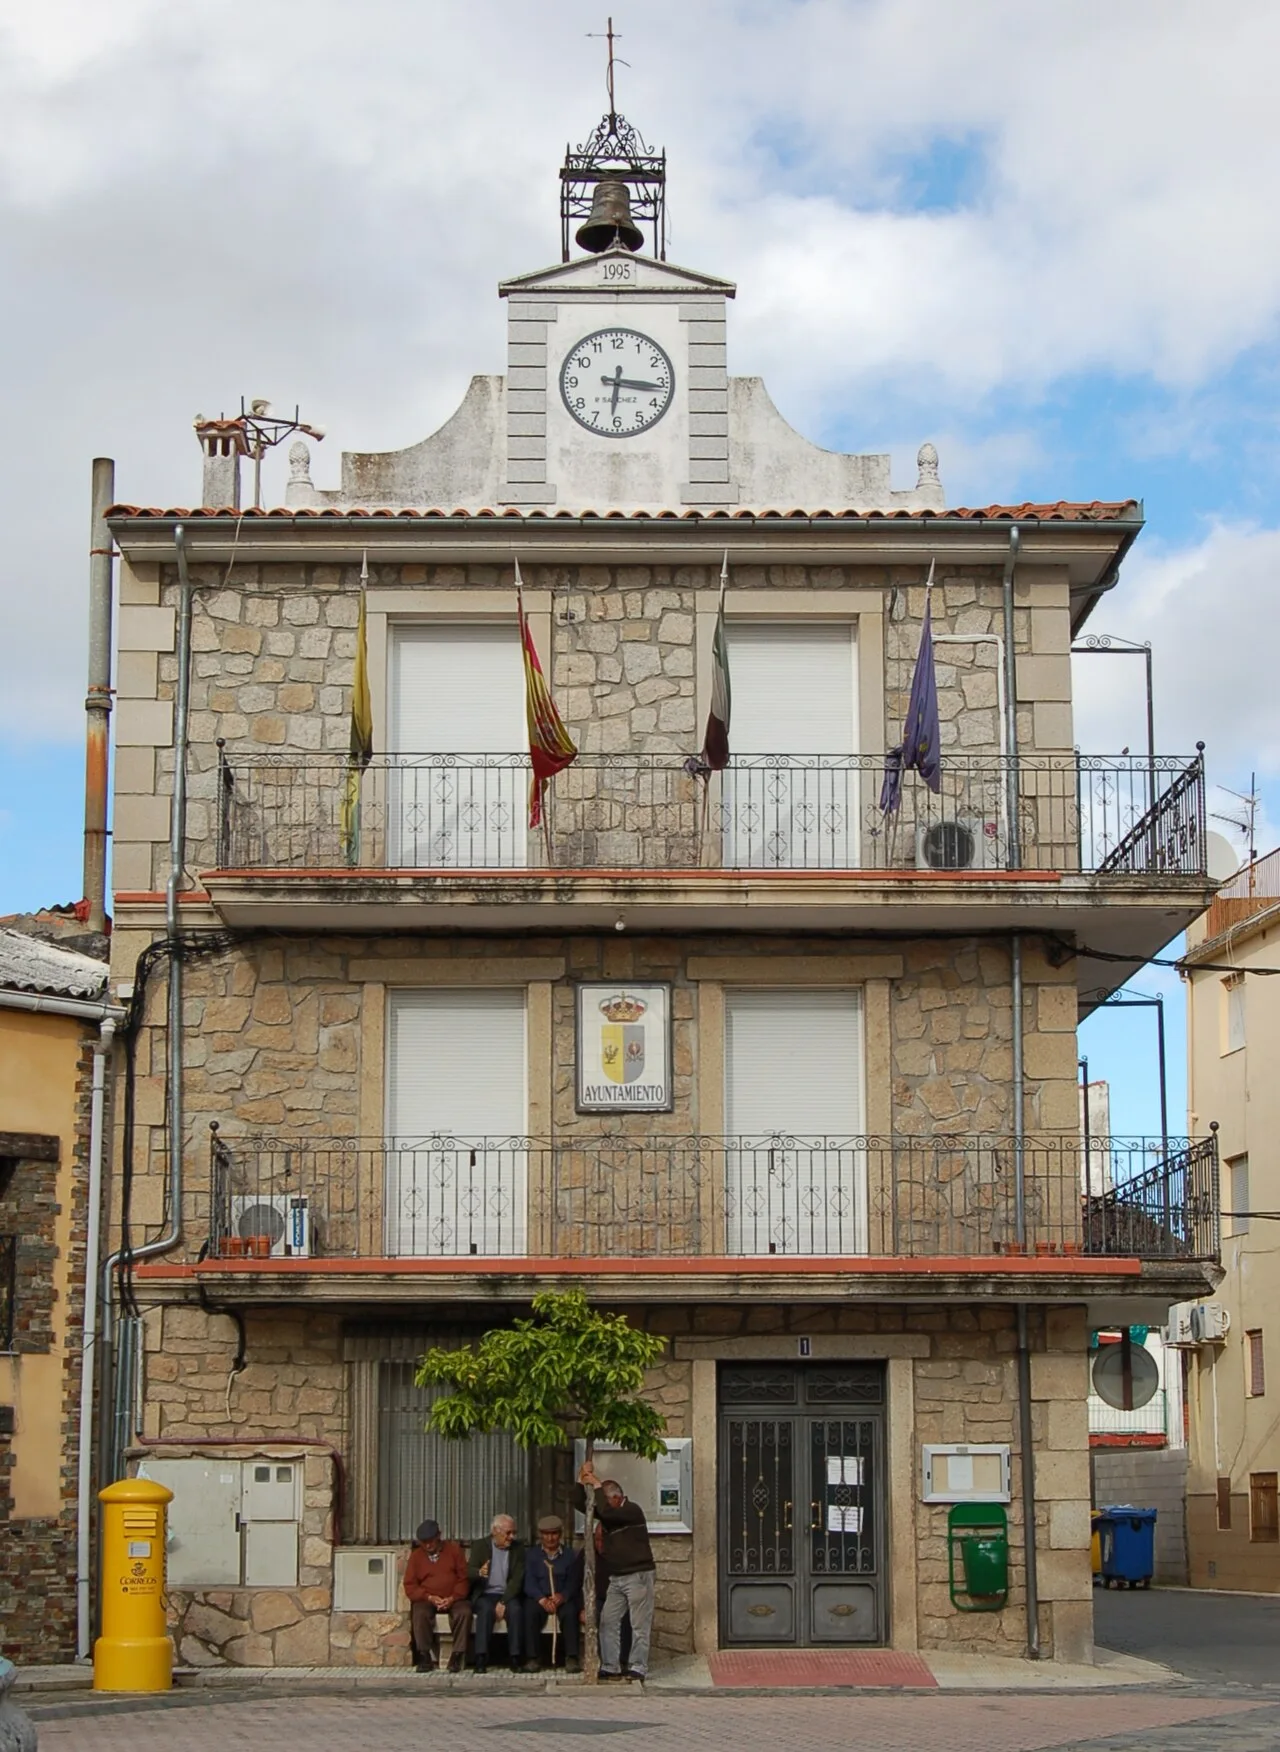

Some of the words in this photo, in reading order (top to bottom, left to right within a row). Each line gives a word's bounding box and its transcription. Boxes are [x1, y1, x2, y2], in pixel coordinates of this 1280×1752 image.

[603, 264, 630, 280] 1995
[592, 342, 603, 353] 11
[610, 338, 624, 350] 12
[635, 343, 641, 354] 1
[577, 356, 591, 369] 10
[650, 356, 659, 368] 2
[569, 376, 579, 388] 9
[656, 377, 666, 389] 3
[576, 397, 586, 410] 8
[649, 398, 658, 409] 4
[591, 411, 600, 423] 7
[612, 416, 622, 428] 6
[635, 411, 644, 424] 5
[584, 1085, 664, 1102] AYUNTAMIENTO
